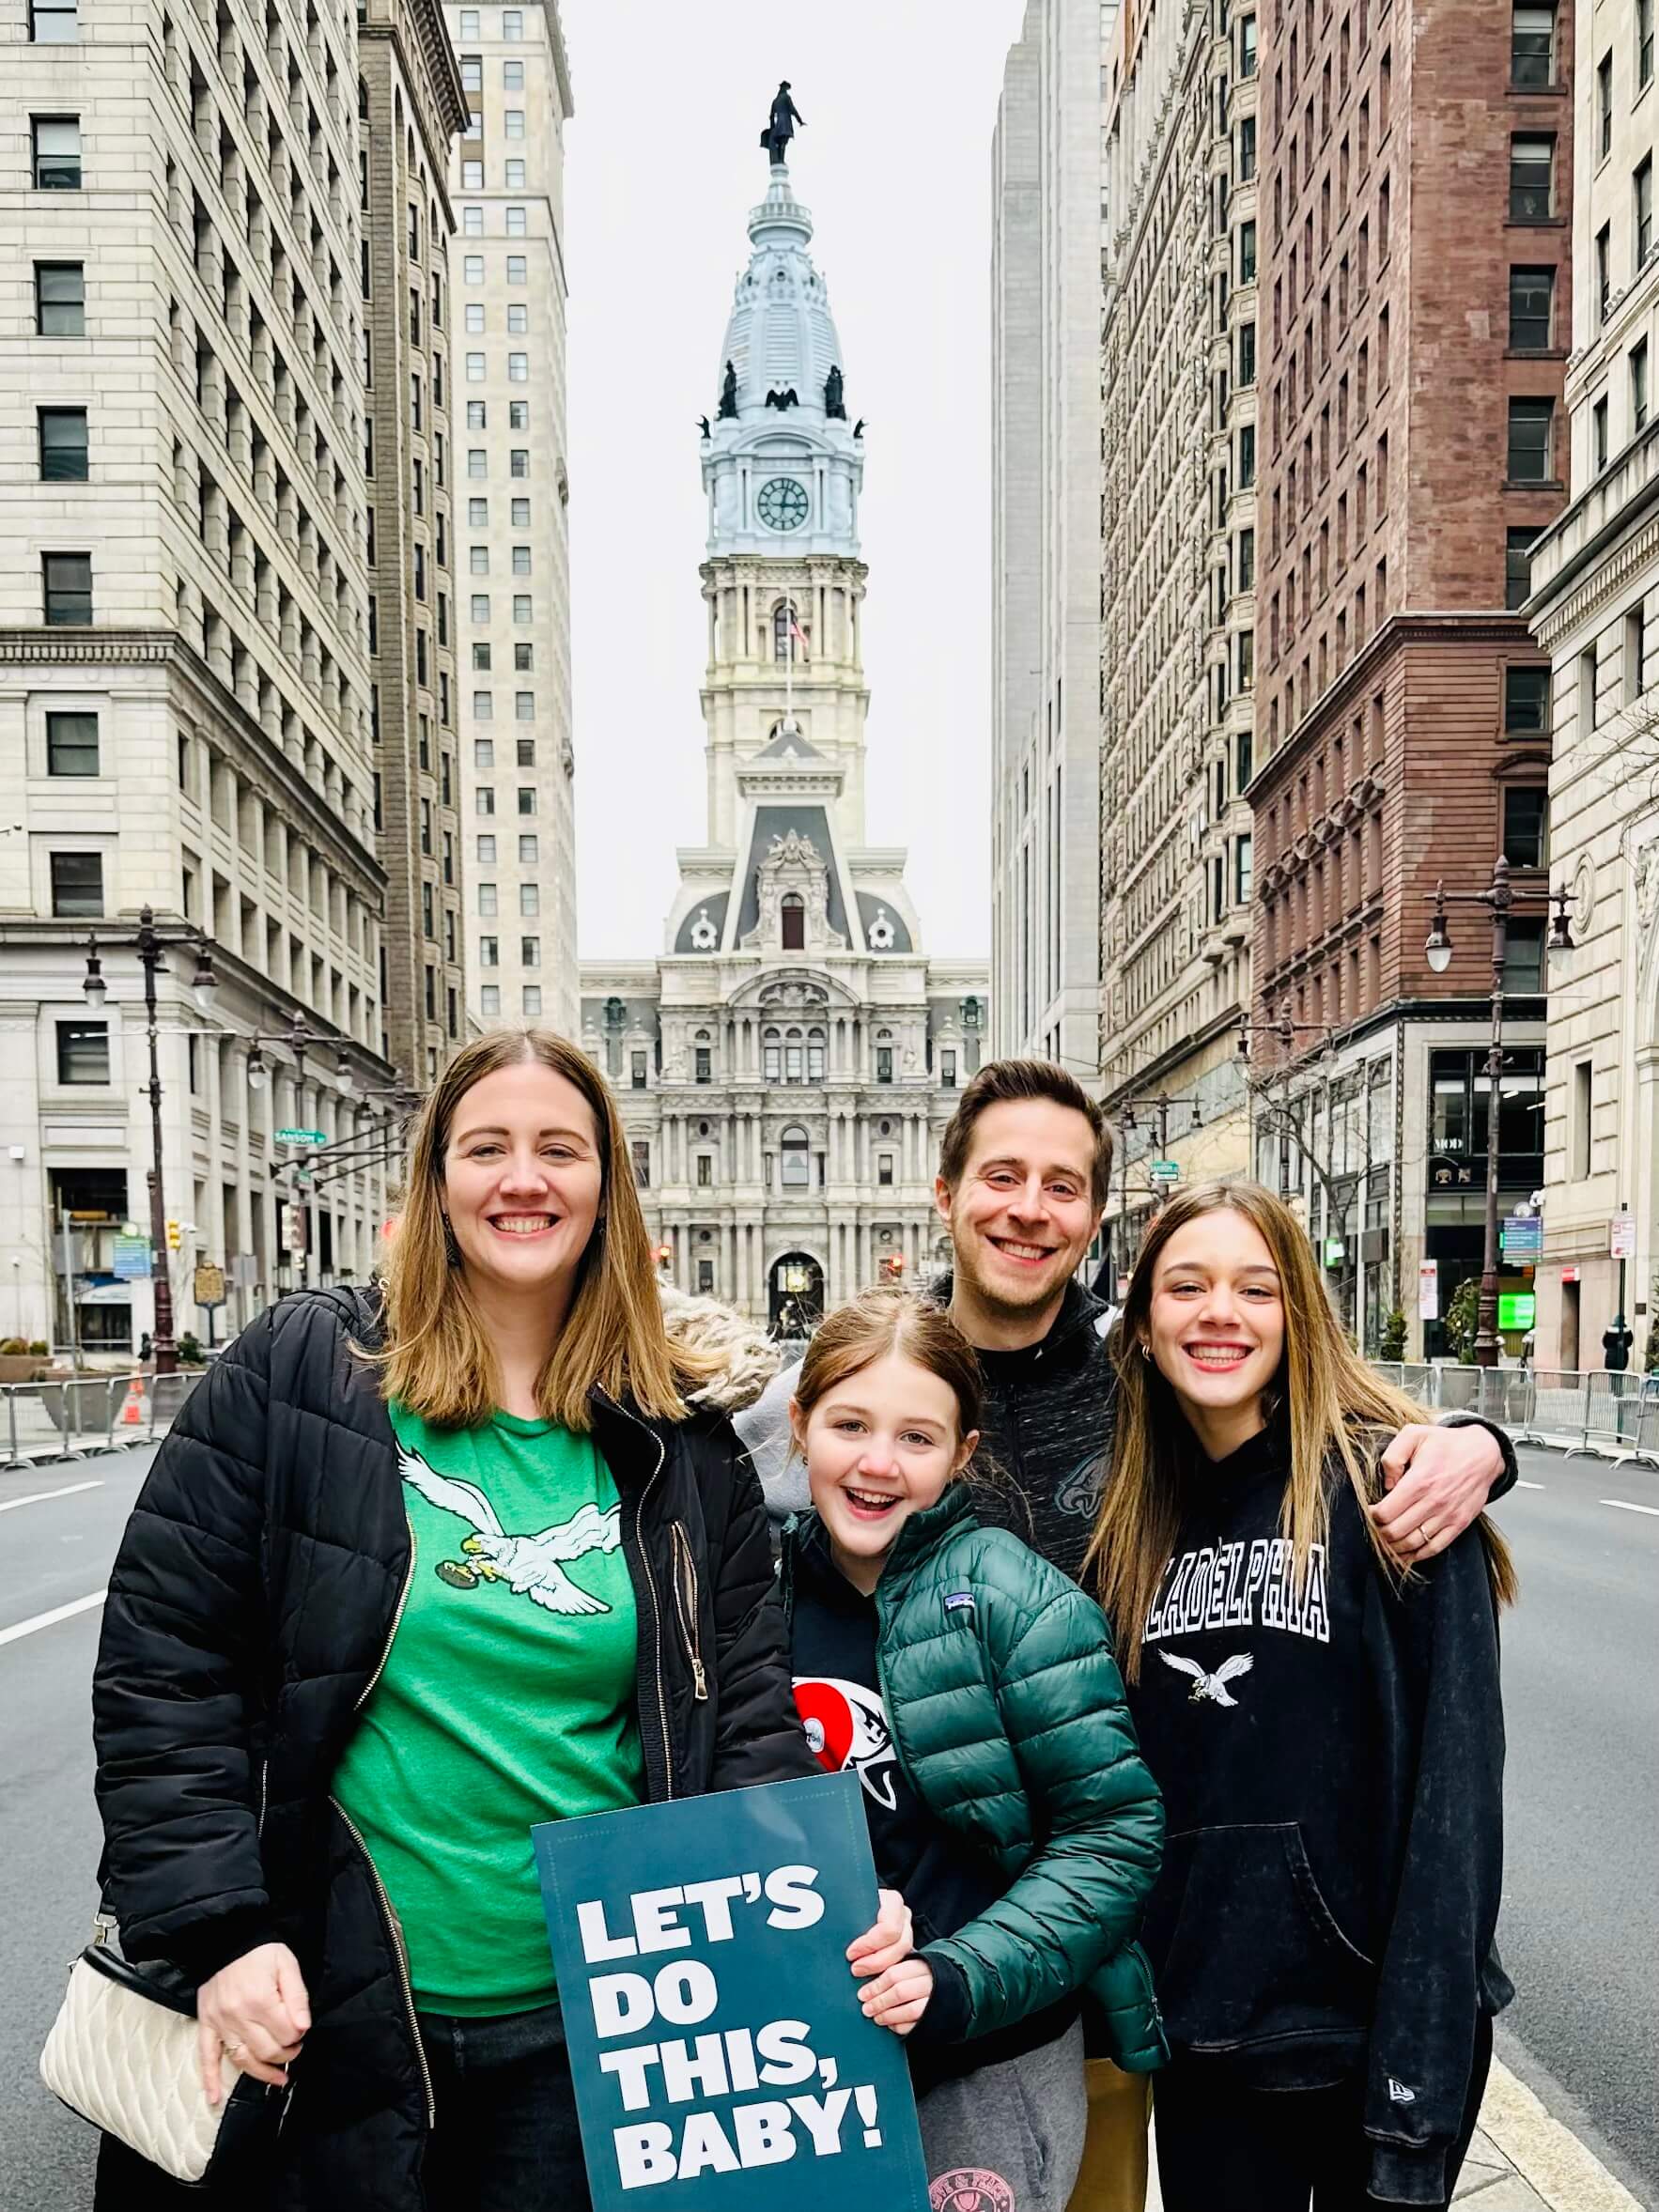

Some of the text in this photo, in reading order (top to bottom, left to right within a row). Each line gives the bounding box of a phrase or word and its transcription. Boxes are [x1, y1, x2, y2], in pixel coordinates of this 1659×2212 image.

[274, 1132, 316, 1142] SANSOM
[576, 1864, 826, 1964] LET'S
[588, 1959, 719, 2039] DO
[598, 2019, 839, 2111] THIS,
[612, 2084, 883, 2190] BABY!
